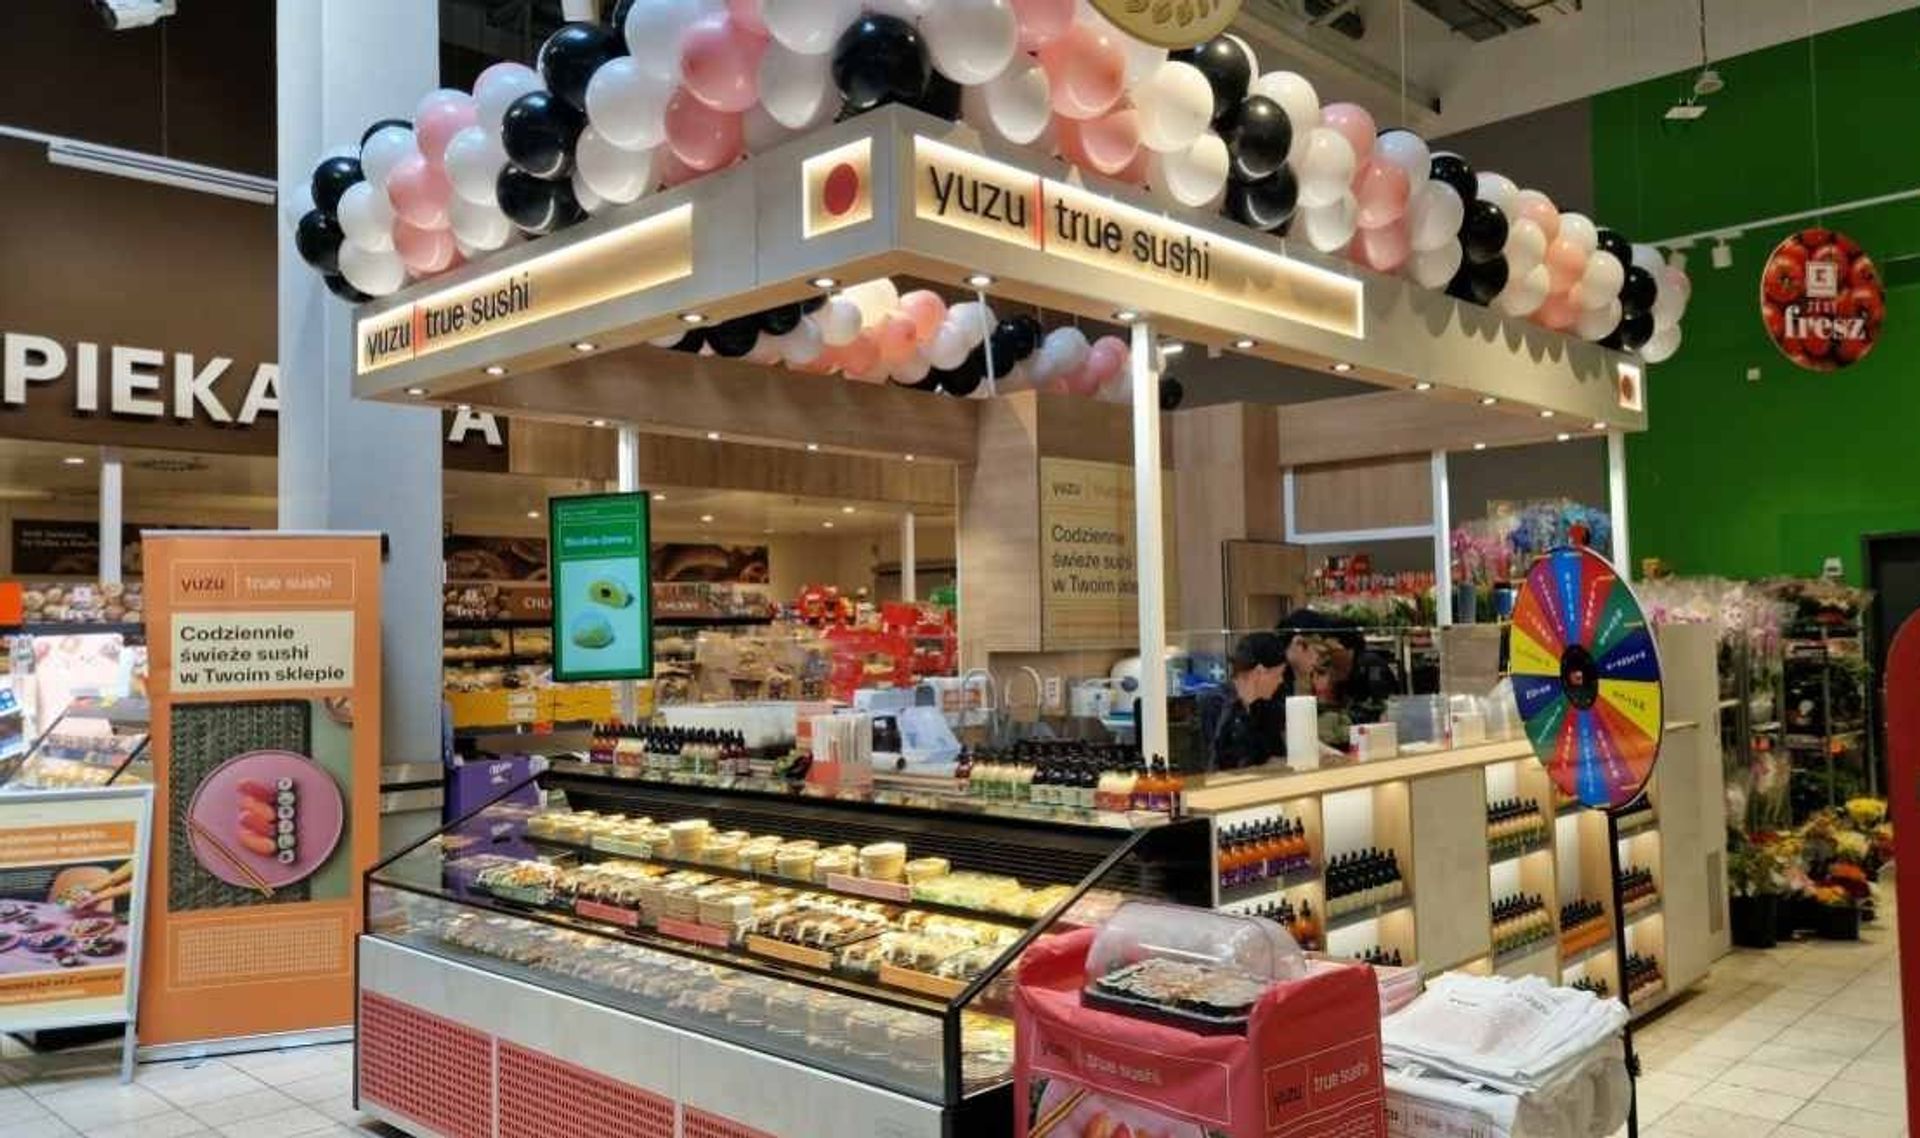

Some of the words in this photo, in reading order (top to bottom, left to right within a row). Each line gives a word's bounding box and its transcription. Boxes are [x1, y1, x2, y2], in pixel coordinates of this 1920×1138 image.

[929, 164, 1027, 231] yuzu
[1054, 197, 1123, 254] true
[1132, 224, 1211, 282] sushi
[366, 317, 411, 362] yuzu
[425, 303, 464, 340] true
[471, 271, 530, 324] sushi
[180, 575, 226, 592] yuzu
[285, 572, 333, 590] sushi
[179, 624, 296, 643] Codziennie
[179, 646, 252, 664] świeże
[256, 644, 310, 662] sushi
[179, 671, 199, 684] w
[204, 666, 271, 684] Twoim
[275, 664, 345, 683] sklepie
[1313, 1067, 1339, 1093] true
[1341, 1058, 1371, 1085] sushi
